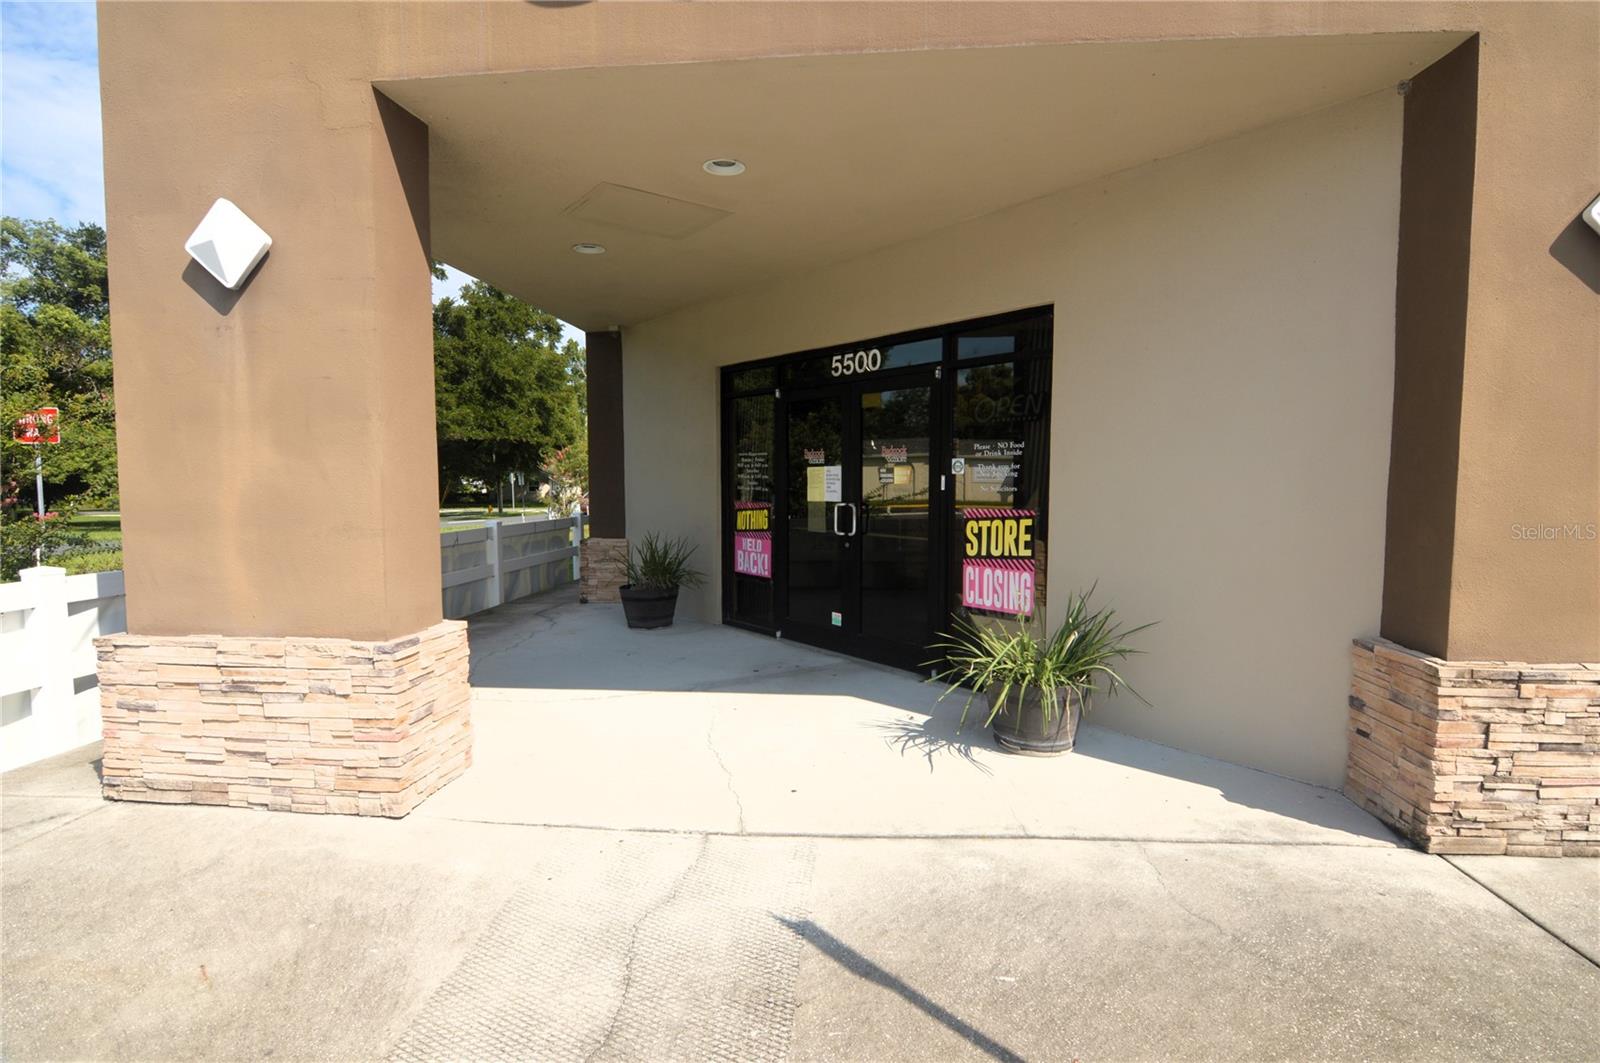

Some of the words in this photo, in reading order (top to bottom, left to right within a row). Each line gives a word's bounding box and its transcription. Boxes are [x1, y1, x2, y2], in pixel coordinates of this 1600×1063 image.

[831, 349, 881, 377] 5500
[975, 393, 1044, 423] OPEN
[1009, 441, 1025, 449] Food
[736, 509, 769, 530] NOTHING
[742, 538, 762, 552] HELD
[965, 519, 1033, 557] STORE
[737, 550, 768, 576] BACK!
[965, 566, 1032, 613] CLOSING
